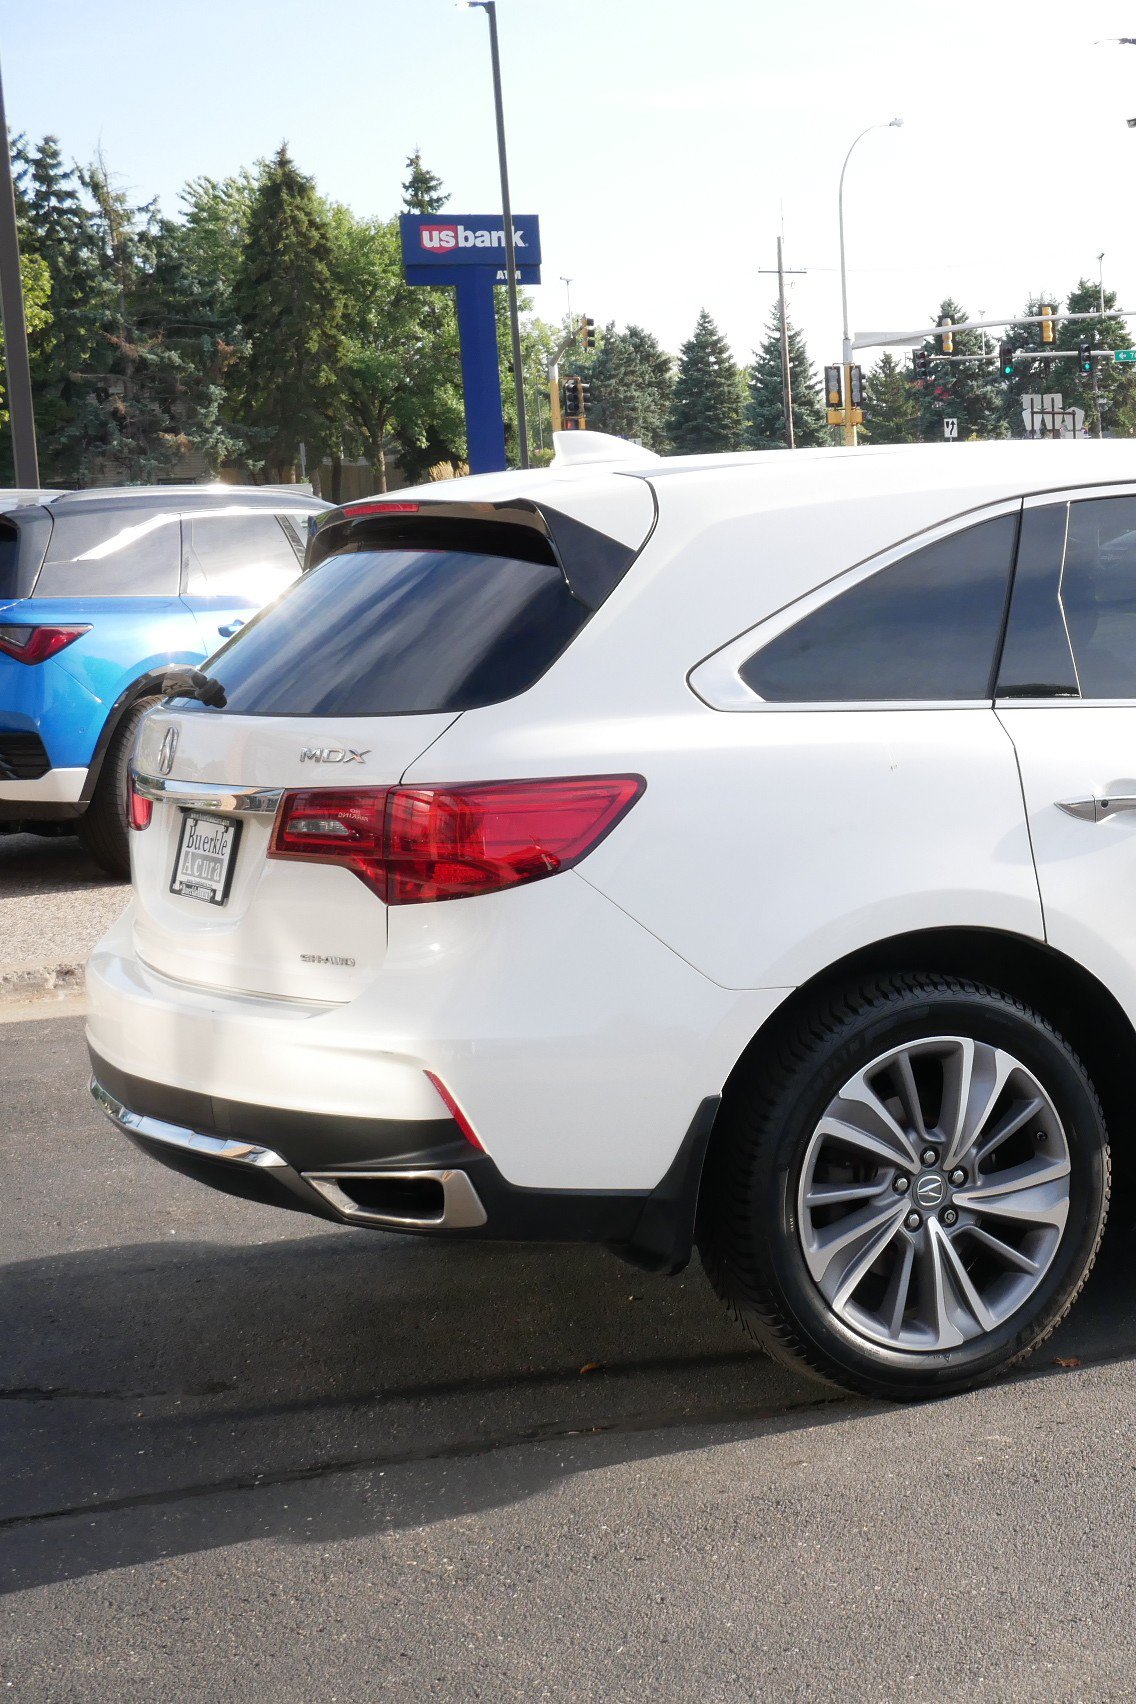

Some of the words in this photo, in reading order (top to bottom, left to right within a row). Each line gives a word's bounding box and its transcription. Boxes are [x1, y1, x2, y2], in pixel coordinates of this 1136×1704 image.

[300, 748, 372, 763] MDX
[186, 825, 228, 856] Buerkle
[183, 851, 221, 881] Acura
